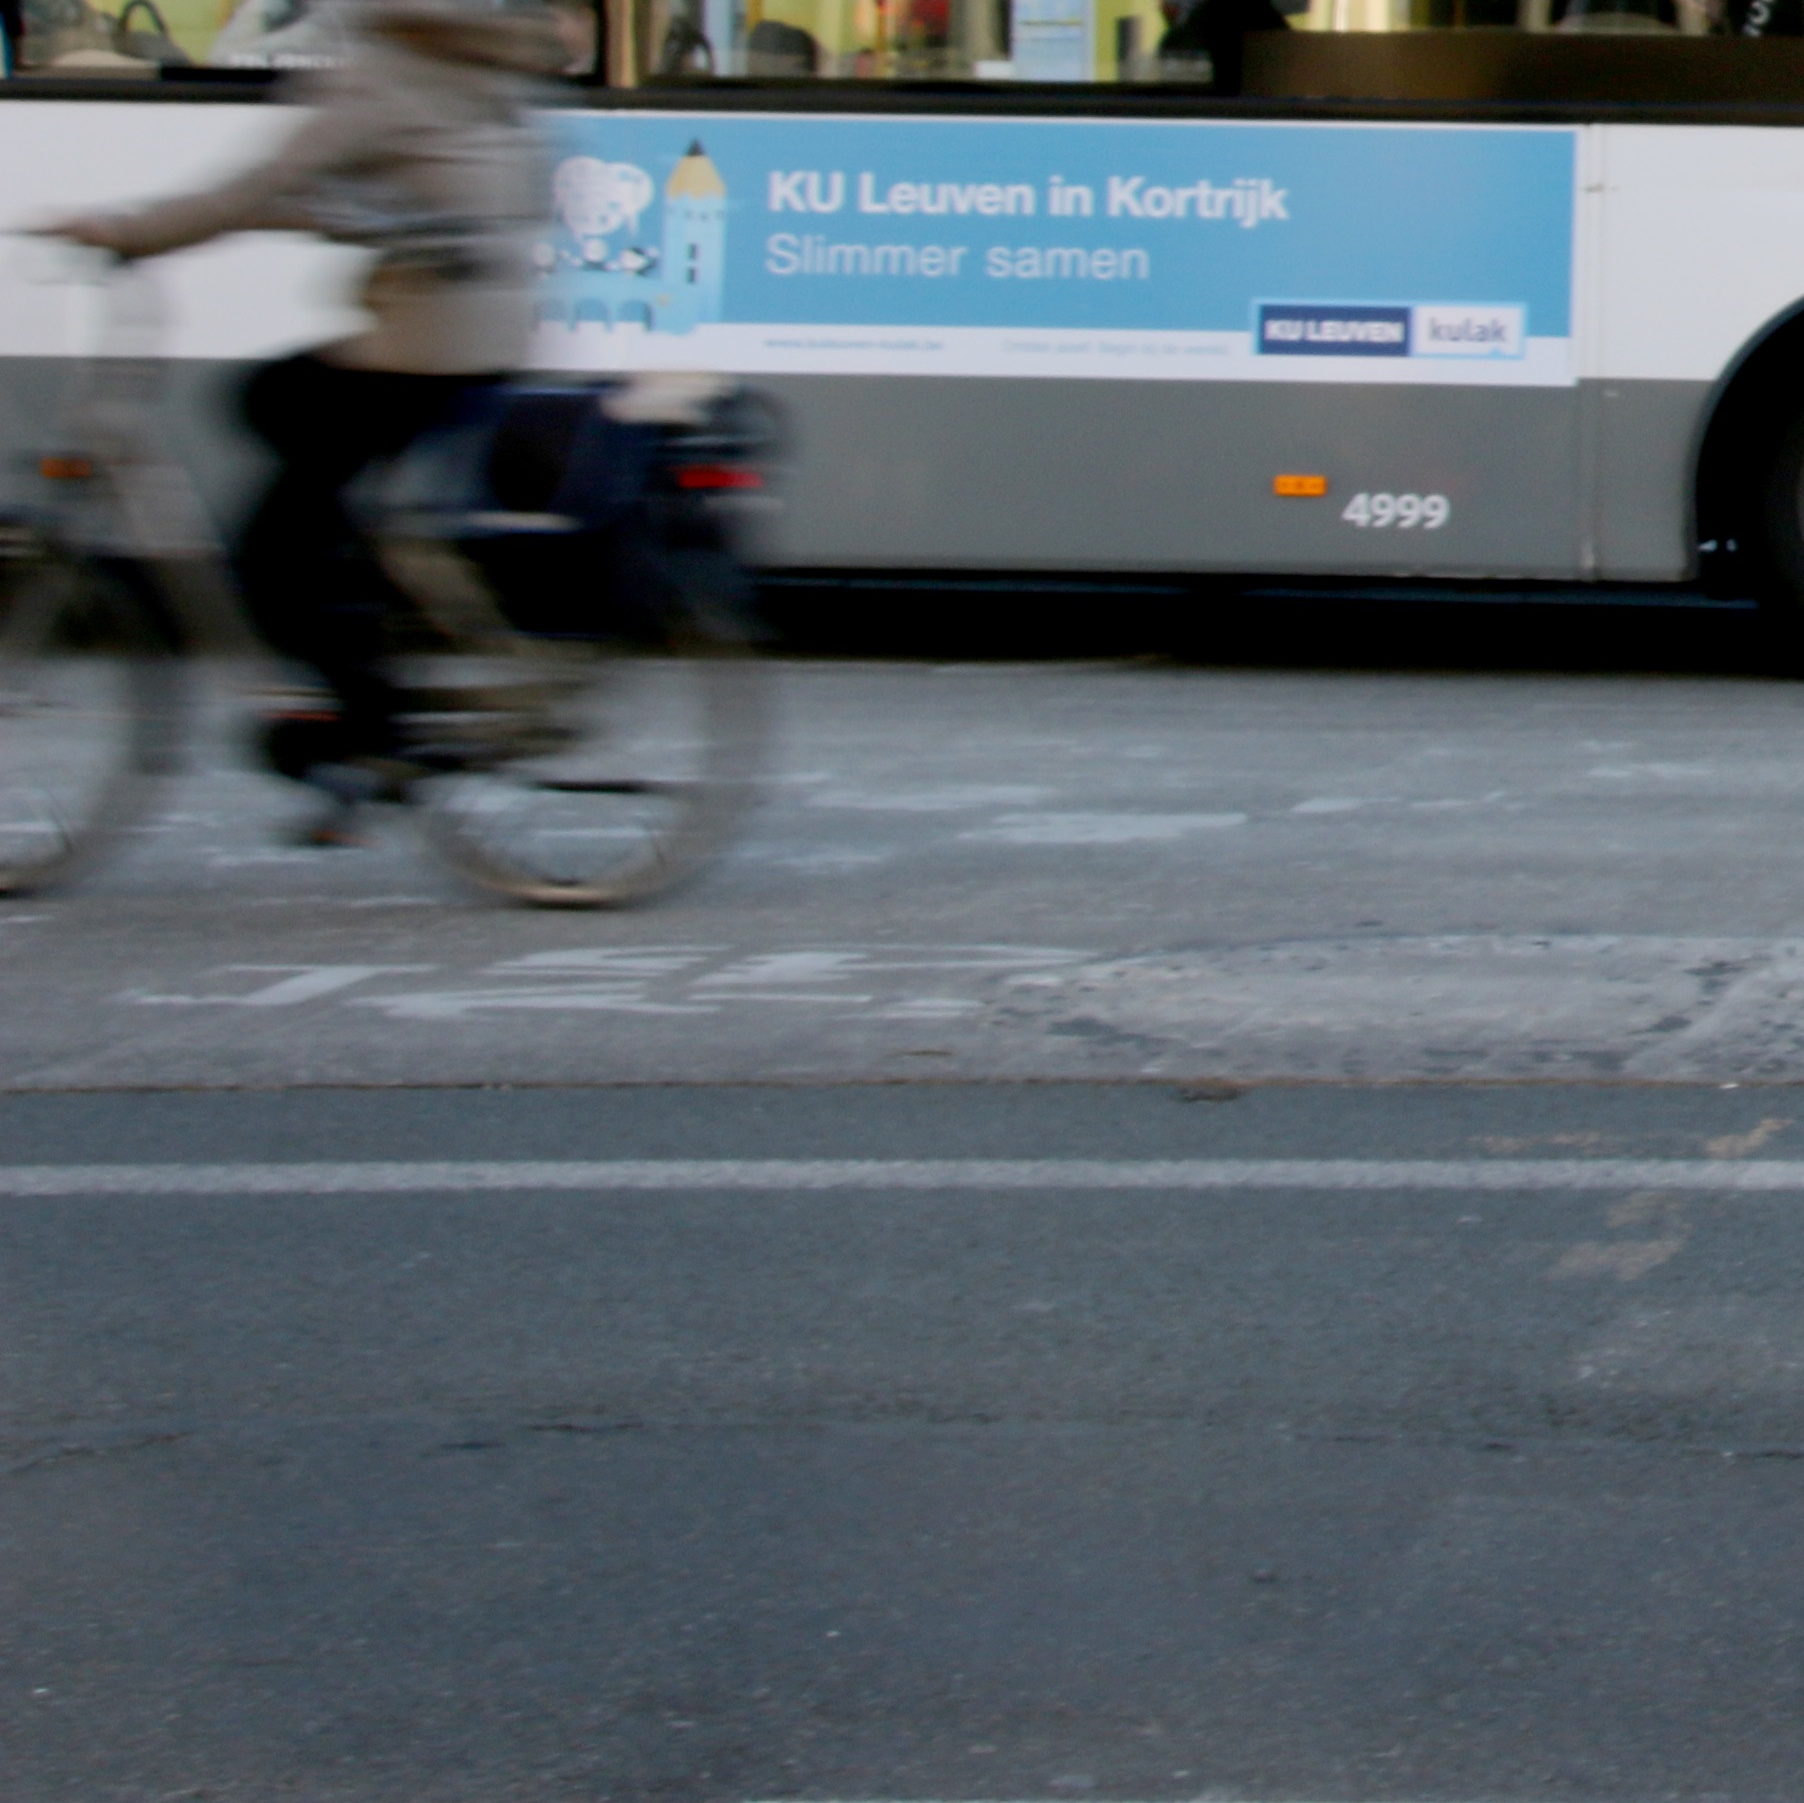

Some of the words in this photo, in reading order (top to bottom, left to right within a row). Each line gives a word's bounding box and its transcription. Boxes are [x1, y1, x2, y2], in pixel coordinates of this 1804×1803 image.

[768, 170, 844, 214] KU
[858, 171, 1036, 216] Leuven
[1047, 175, 1092, 216] in
[1107, 175, 1289, 229] Kortrijk
[765, 232, 968, 276] Slimmer
[986, 245, 1150, 280] samen
[1263, 319, 1303, 342] KU
[1305, 320, 1405, 344] LEUVEN
[1429, 316, 1507, 343] kulak
[1341, 492, 1451, 530] 4999
